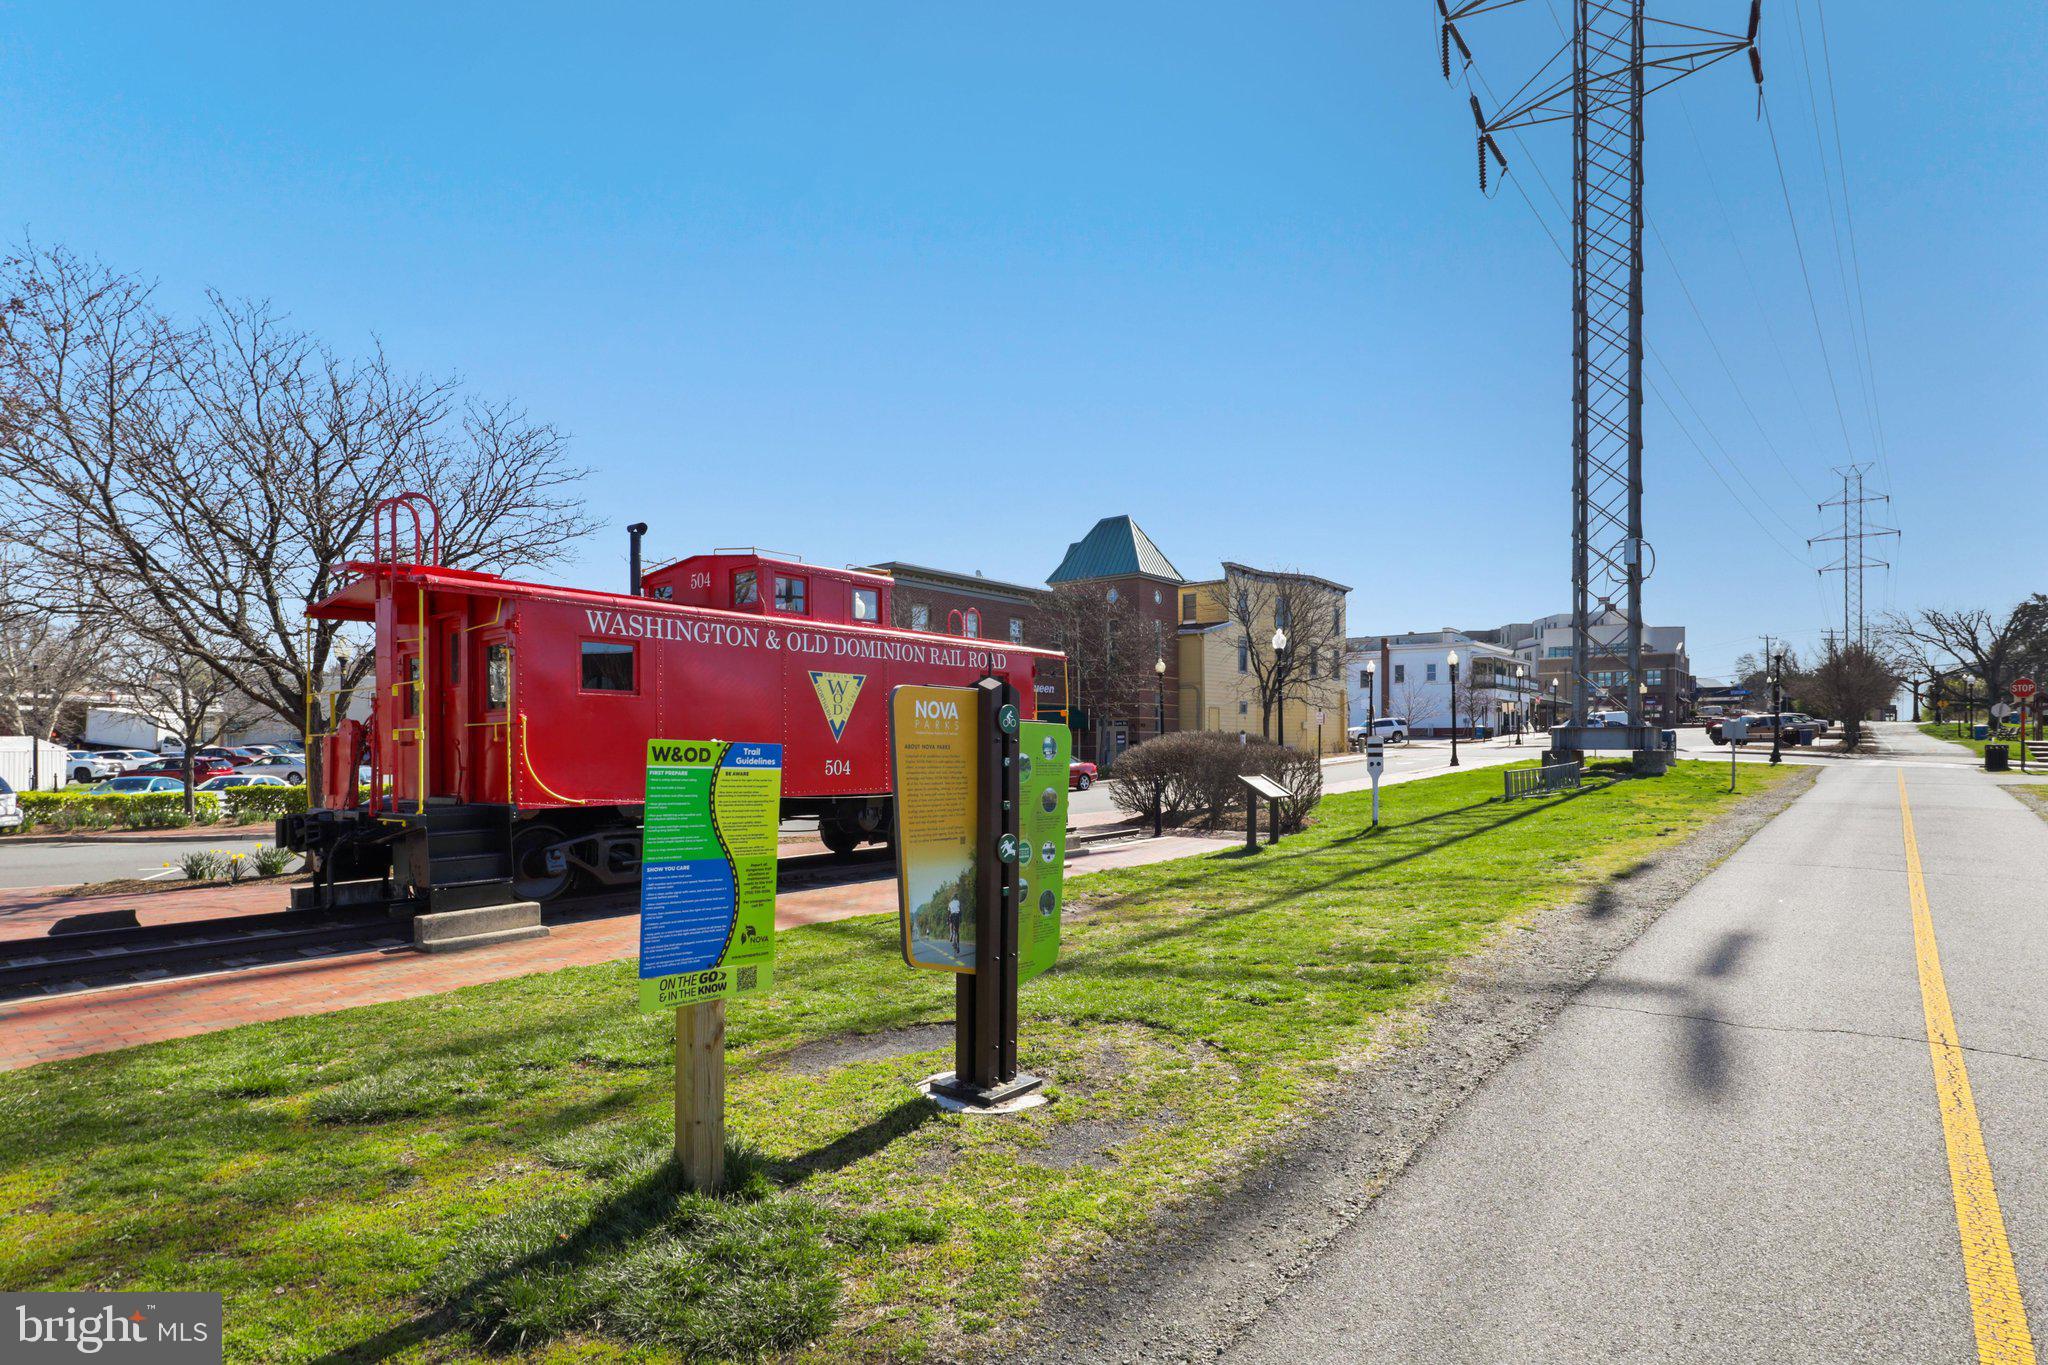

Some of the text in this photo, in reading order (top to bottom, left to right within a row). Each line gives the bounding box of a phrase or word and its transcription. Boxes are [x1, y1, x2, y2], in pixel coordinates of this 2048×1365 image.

[690, 571, 711, 590] 504
[585, 609, 1007, 669] WASHINGTON & OLD DOMINION RAIL ROAD
[1033, 684, 1055, 694] ueen
[2012, 684, 2034, 692] STOP
[915, 699, 959, 720] NOVA
[915, 720, 959, 731] PARKS
[651, 746, 712, 763] W&OD
[743, 747, 761, 756] Trail
[735, 757, 776, 766] Guidelines
[825, 759, 851, 776] 504
[750, 936, 769, 944] NOVA
[659, 971, 718, 991] ON THE GO
[668, 991, 678, 1001] IN
[679, 987, 697, 999] THE
[698, 982, 727, 996] KNOW
